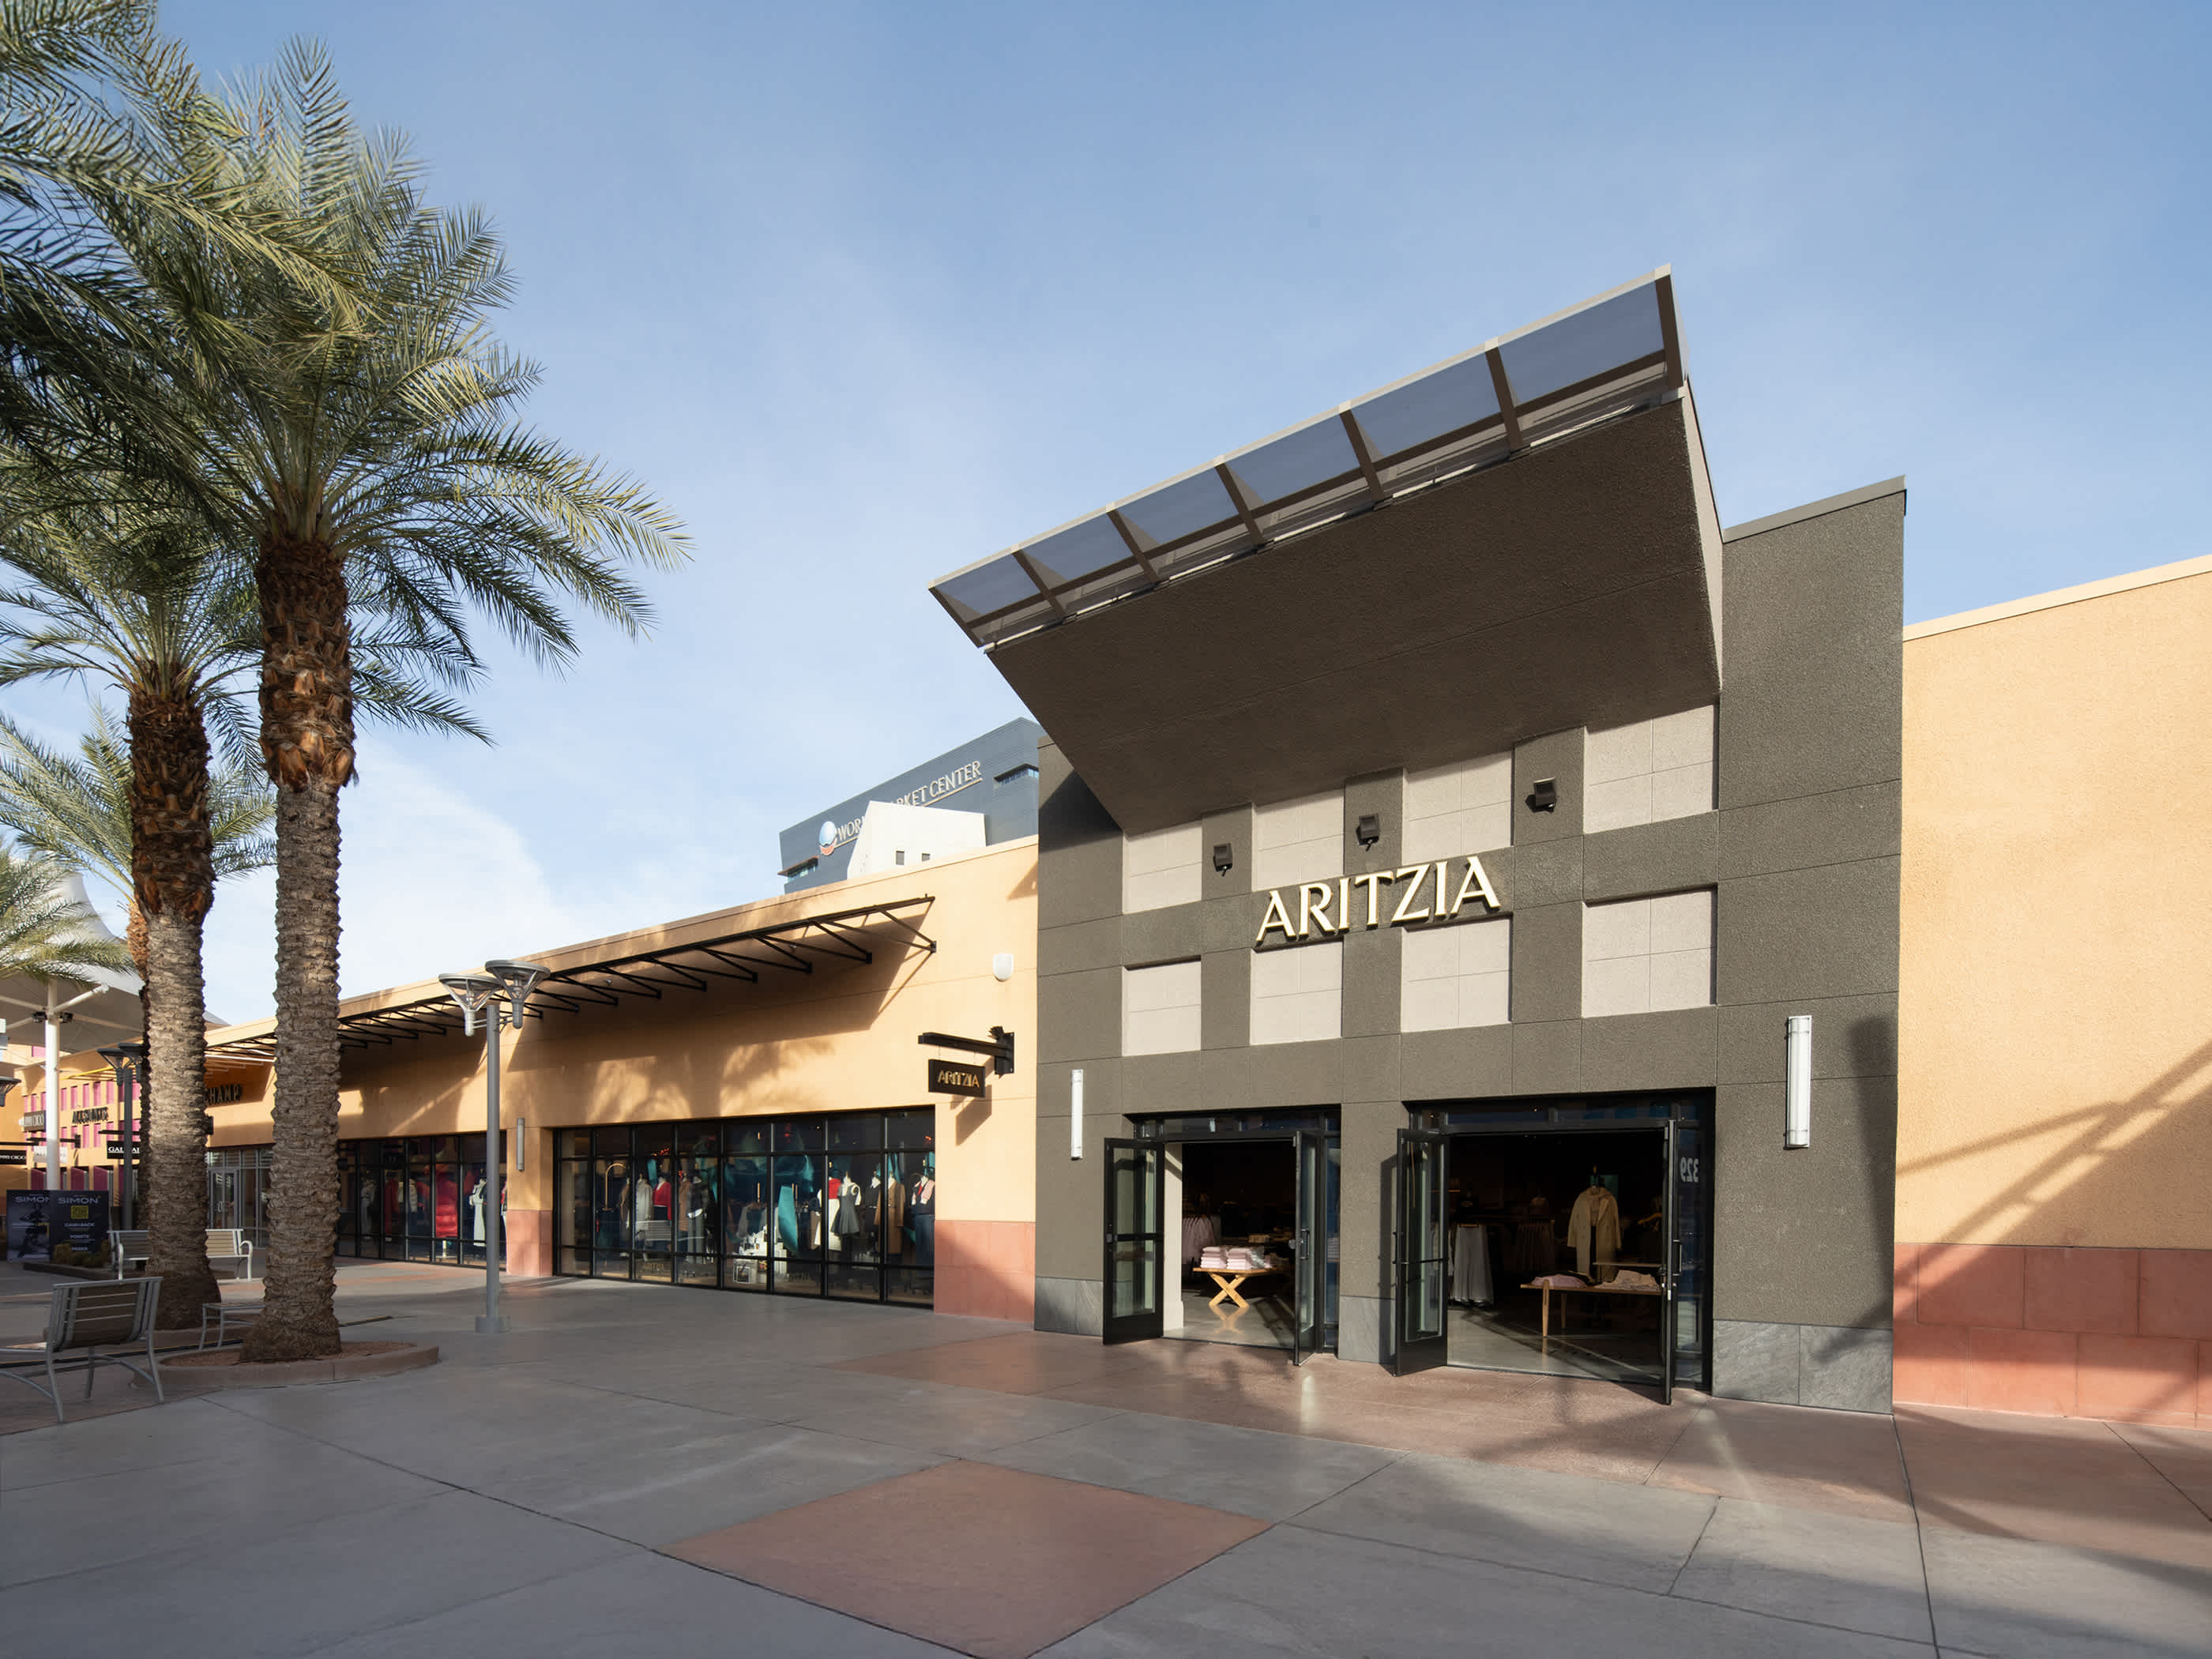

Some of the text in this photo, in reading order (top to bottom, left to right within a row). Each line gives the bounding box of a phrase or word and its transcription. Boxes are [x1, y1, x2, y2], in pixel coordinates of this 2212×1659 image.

[837, 761, 981, 841] WOR RKET CENTER
[1256, 856, 1501, 942] ARITZIA
[938, 1070, 980, 1087] ARITZIA
